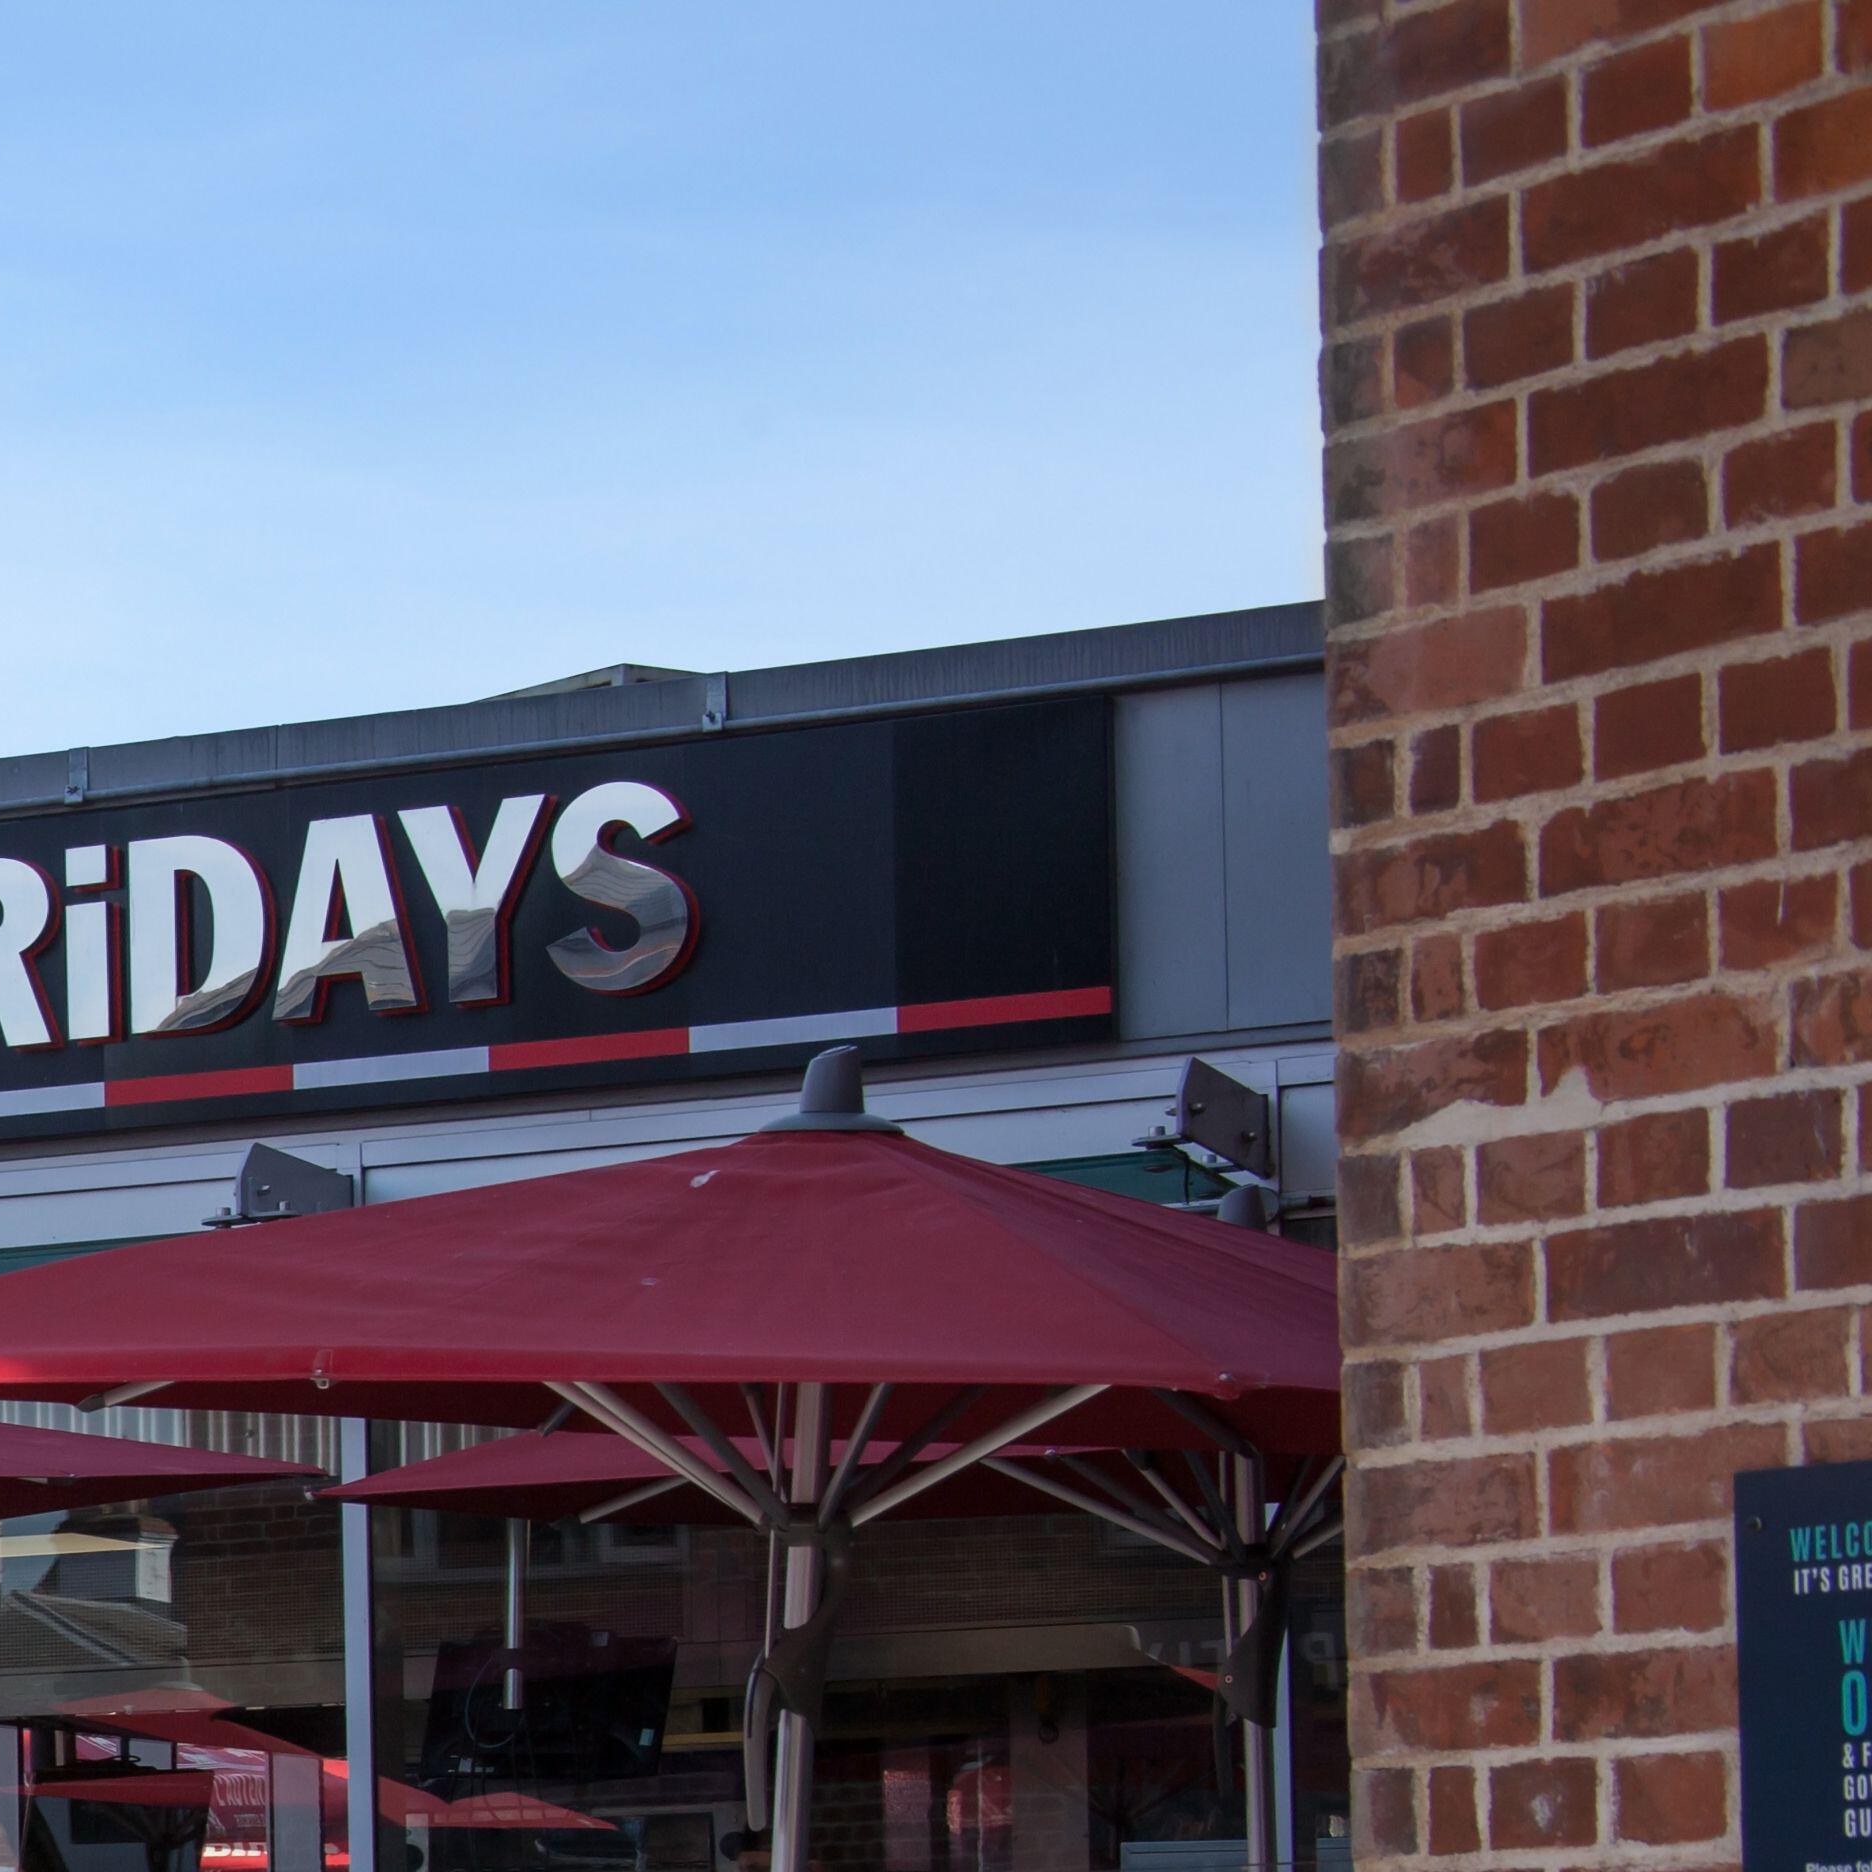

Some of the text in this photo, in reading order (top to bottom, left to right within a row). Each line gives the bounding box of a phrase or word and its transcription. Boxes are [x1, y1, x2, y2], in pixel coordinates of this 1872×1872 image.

[1789, 1521, 1872, 1563] WELCO
[1793, 1563, 1872, 1595] IT'S GRE
